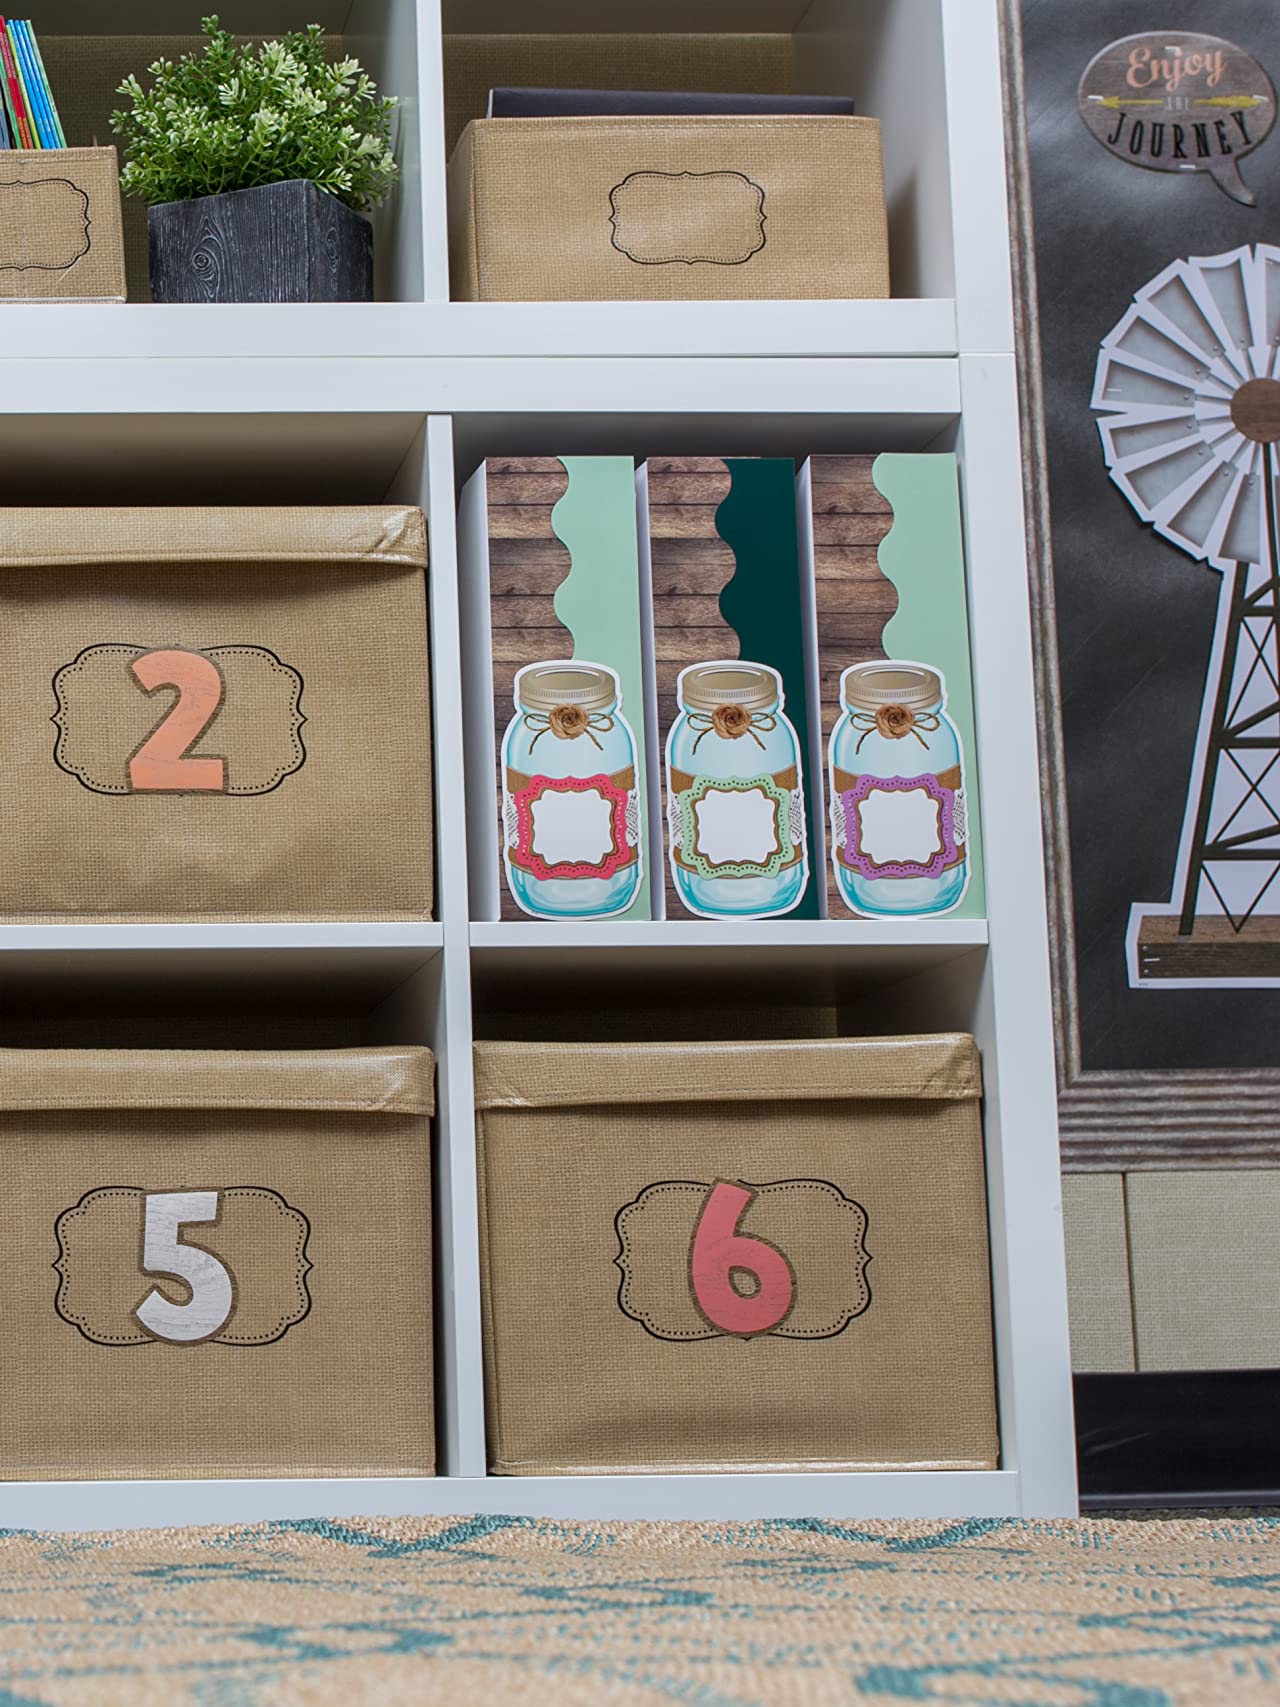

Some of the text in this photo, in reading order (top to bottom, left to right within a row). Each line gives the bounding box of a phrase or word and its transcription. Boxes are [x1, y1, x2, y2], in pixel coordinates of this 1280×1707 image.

[1107, 110, 1252, 159] JOURNEY
[1125, 47, 1227, 92] Enjoy
[125, 645, 229, 795] 2
[131, 1187, 239, 1346] 5
[687, 1177, 797, 1337] 6
